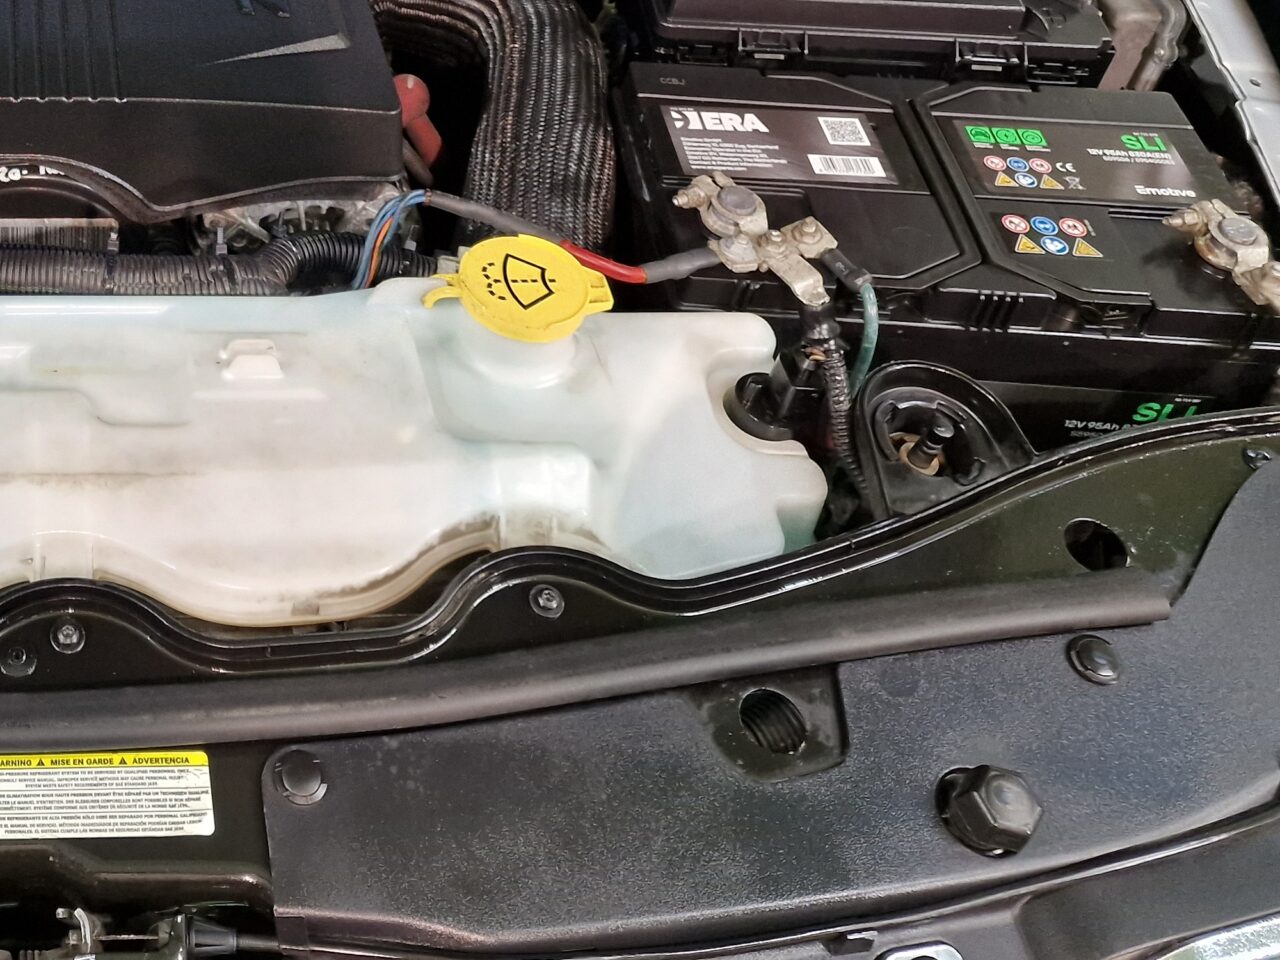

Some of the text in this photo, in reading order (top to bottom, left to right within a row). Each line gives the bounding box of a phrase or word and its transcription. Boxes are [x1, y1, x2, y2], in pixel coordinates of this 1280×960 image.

[1120, 134, 1167, 152] SLI
[1134, 185, 1197, 198] Emotive
[1064, 420, 1087, 428] 12V
[1087, 421, 1120, 430] 95Ah
[132, 757, 190, 765] ADVERTENCIA
